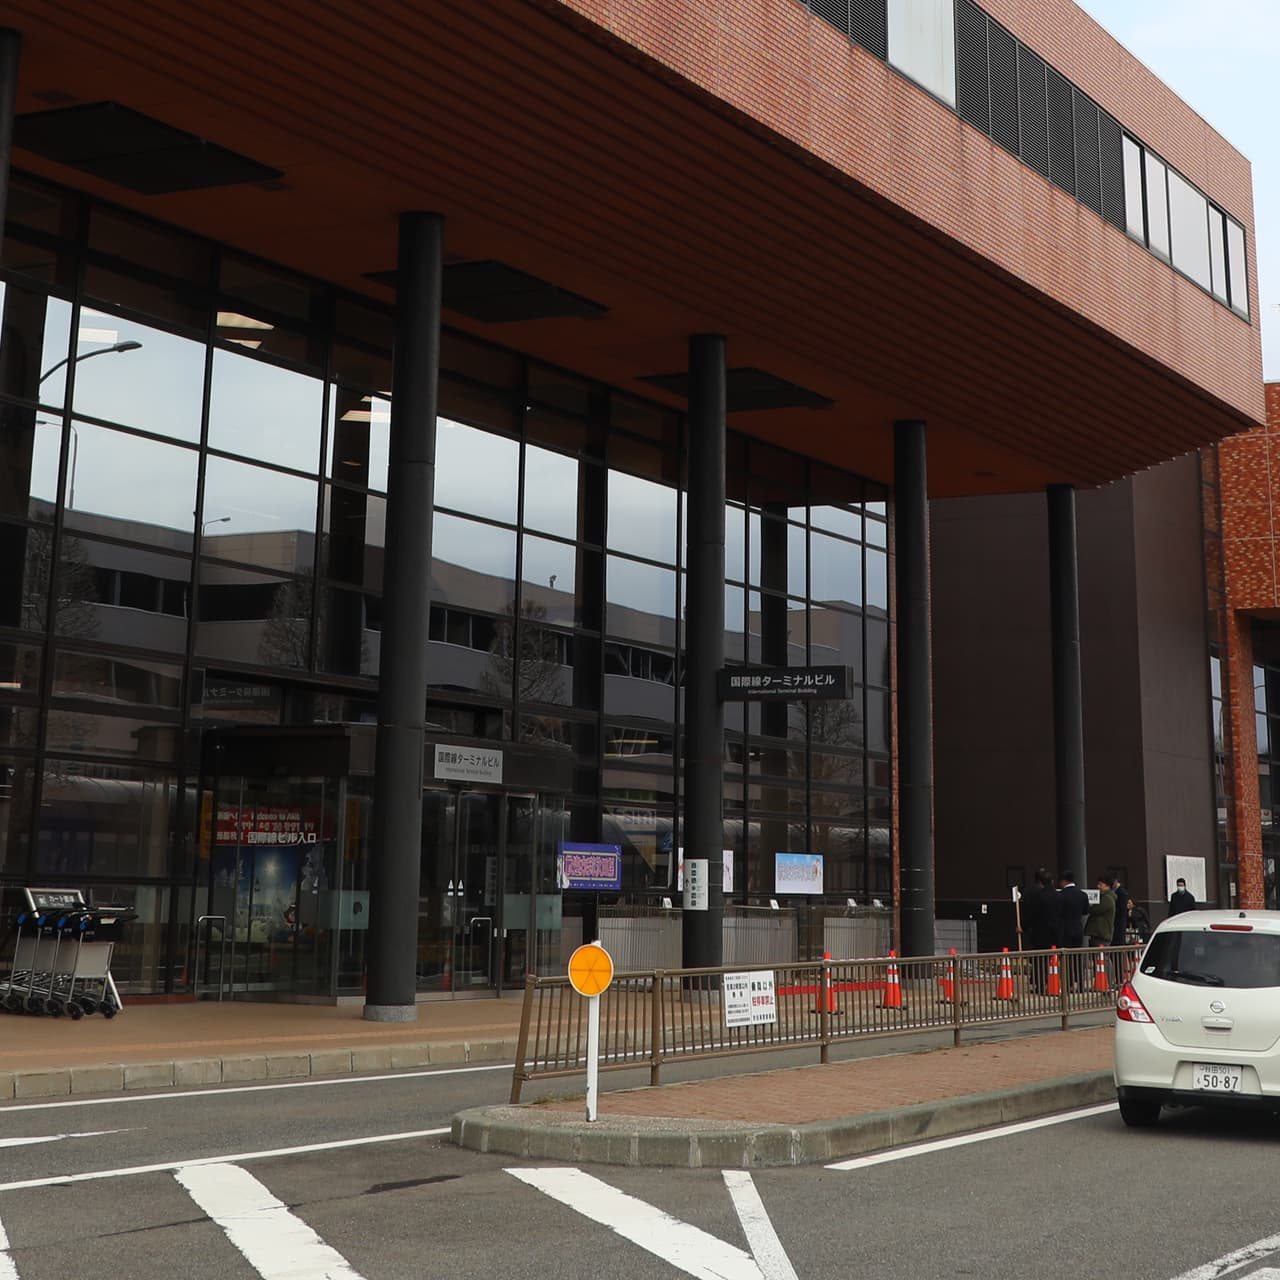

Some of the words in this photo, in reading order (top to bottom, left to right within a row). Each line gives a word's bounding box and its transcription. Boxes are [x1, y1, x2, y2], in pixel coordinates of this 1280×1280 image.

[730, 673, 835, 687] 国際線ターミナルビル
[438, 751, 500, 768] 国際線ターミナルビル
[1203, 1074, 1238, 1089] 50-87
